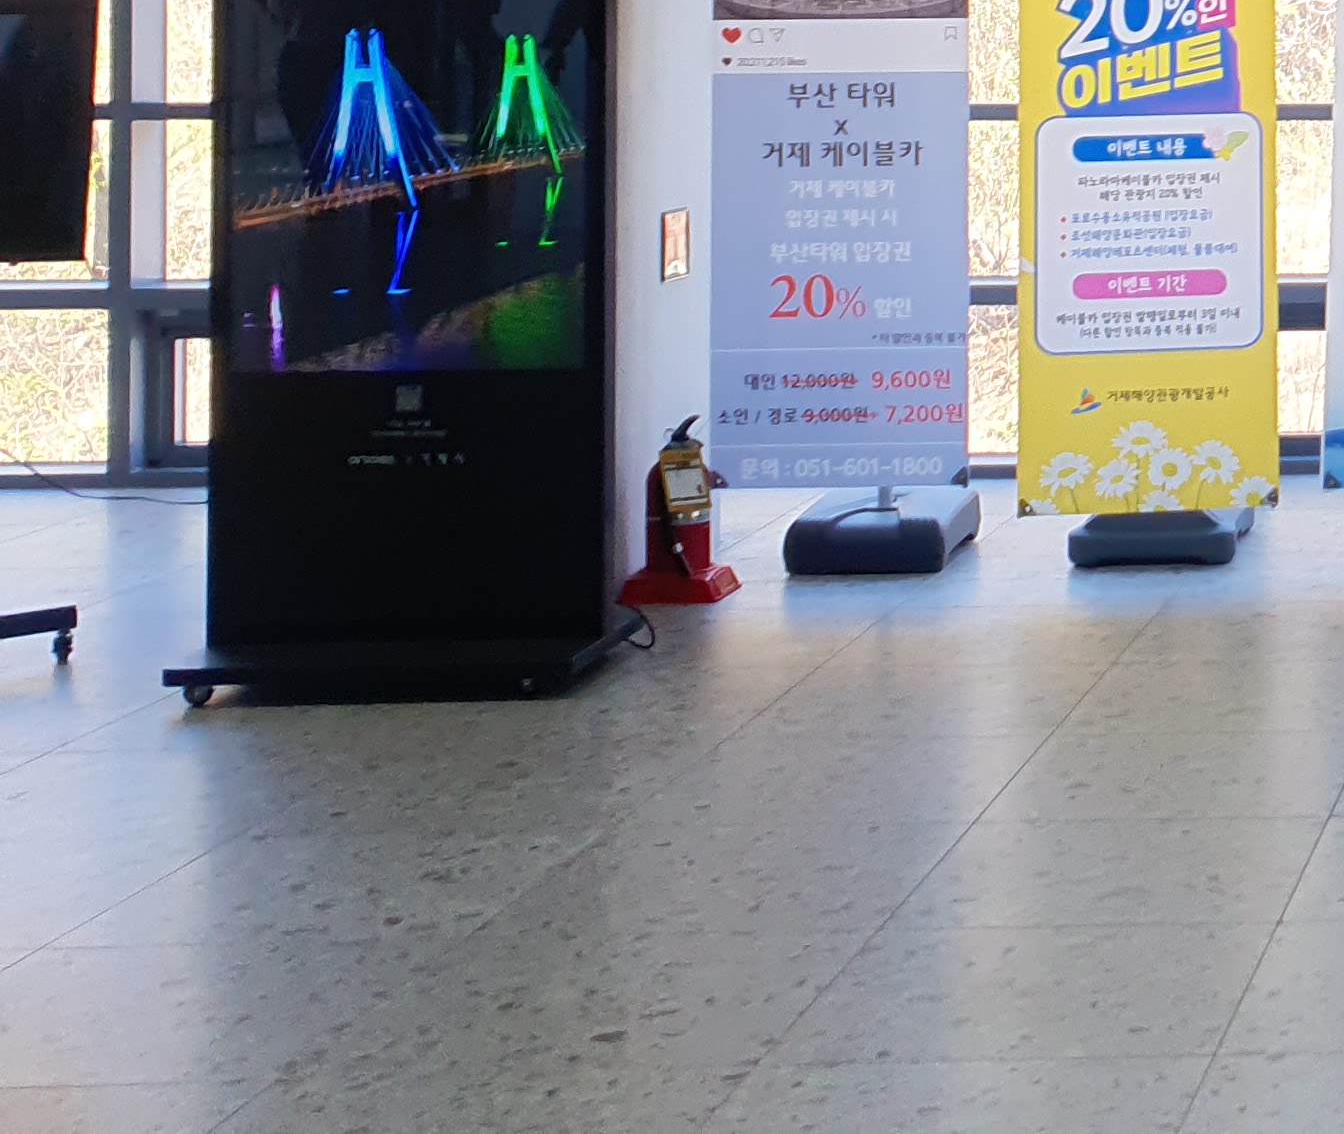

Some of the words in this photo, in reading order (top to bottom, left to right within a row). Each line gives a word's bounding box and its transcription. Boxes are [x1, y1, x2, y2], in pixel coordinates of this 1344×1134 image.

[1060, 29, 1224, 109] 이벤트
[787, 82, 838, 109] 부산
[847, 81, 896, 109] 타워
[762, 141, 810, 168] 거제
[820, 140, 924, 168] 케이블카
[1107, 140, 1153, 159] 이벤트
[1156, 139, 1188, 157] 내용
[789, 179, 824, 199] 거제
[826, 178, 896, 199] 케이블카
[786, 209, 838, 229] 입장권
[843, 208, 877, 228] 제시
[881, 209, 898, 227] 시
[770, 242, 847, 264] 부산타워
[853, 241, 912, 263] 입장권
[1107, 276, 1153, 294] 이벤트
[1157, 274, 1188, 293] 기간
[769, 273, 867, 320] 20%
[873, 298, 913, 319] 할인
[744, 372, 777, 391] 대인
[782, 371, 857, 391] 12,000원
[870, 368, 952, 392] 9,600원
[1107, 386, 1230, 404] 거제해양관광개발공사
[717, 407, 749, 426] 소인
[766, 406, 798, 426] 경로
[884, 403, 964, 426] 7,200원
[741, 457, 779, 479] 문의
[795, 456, 943, 479] 051-601-1800
